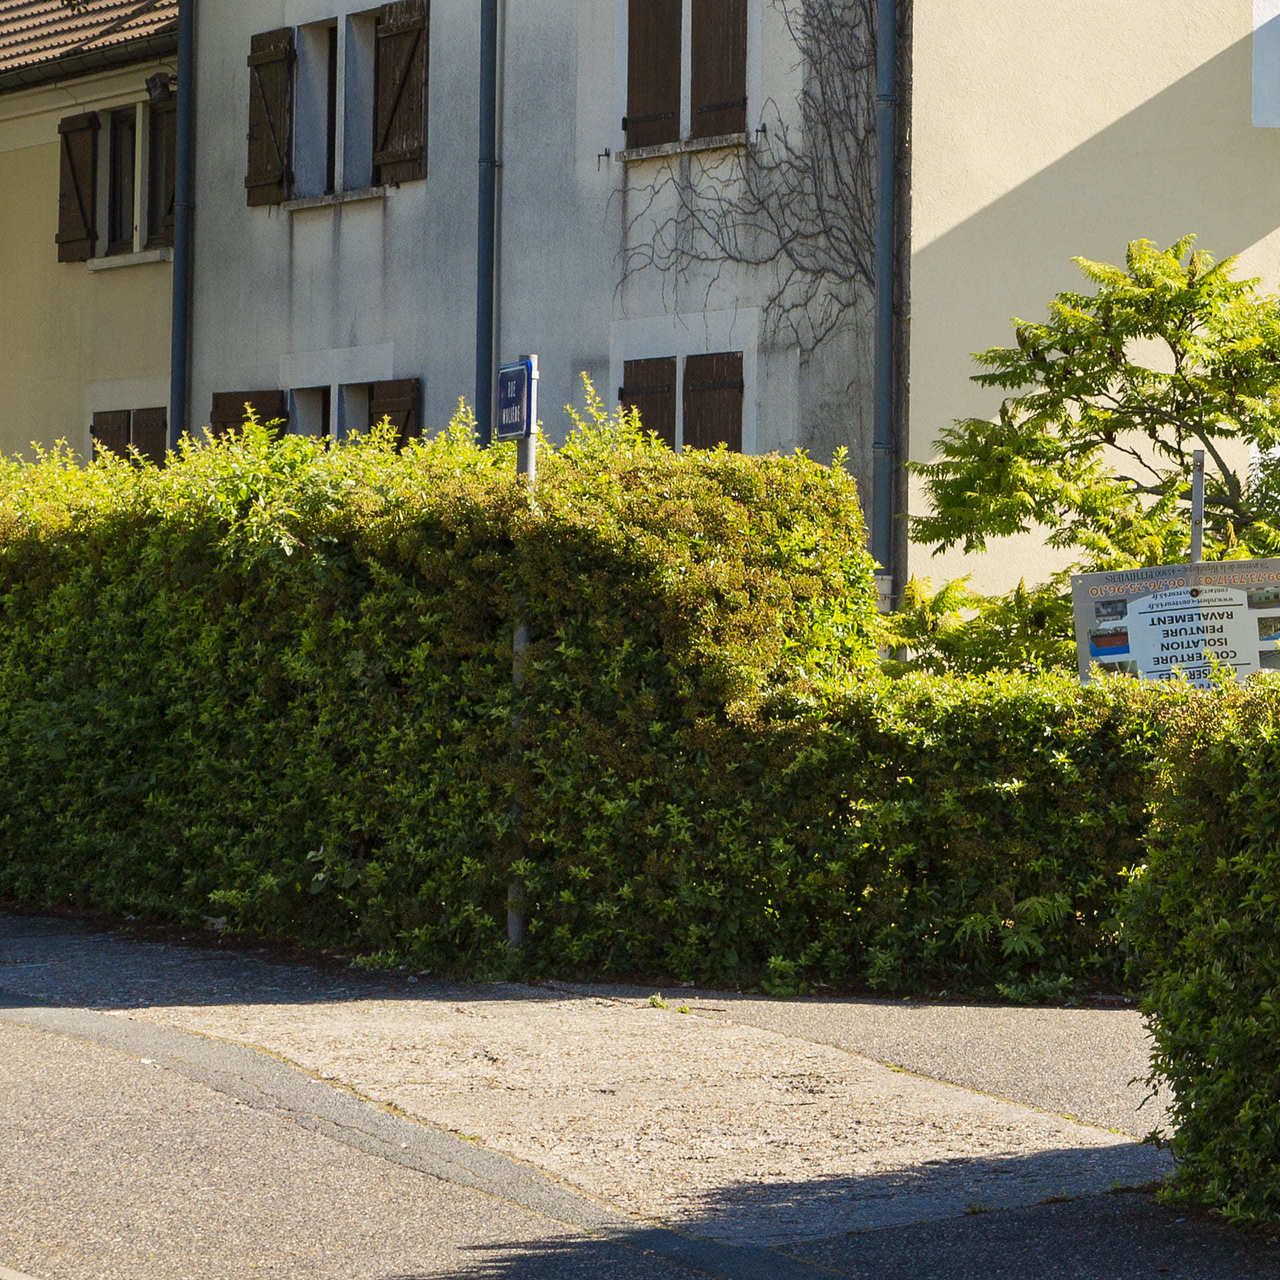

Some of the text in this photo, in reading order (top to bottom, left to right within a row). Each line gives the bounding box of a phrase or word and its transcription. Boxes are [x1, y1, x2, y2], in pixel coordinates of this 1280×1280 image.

[1149, 611, 1234, 626] RAVALEMENT
[1162, 625, 1224, 638] PEINTURE
[1161, 638, 1228, 652] ISOLATION
